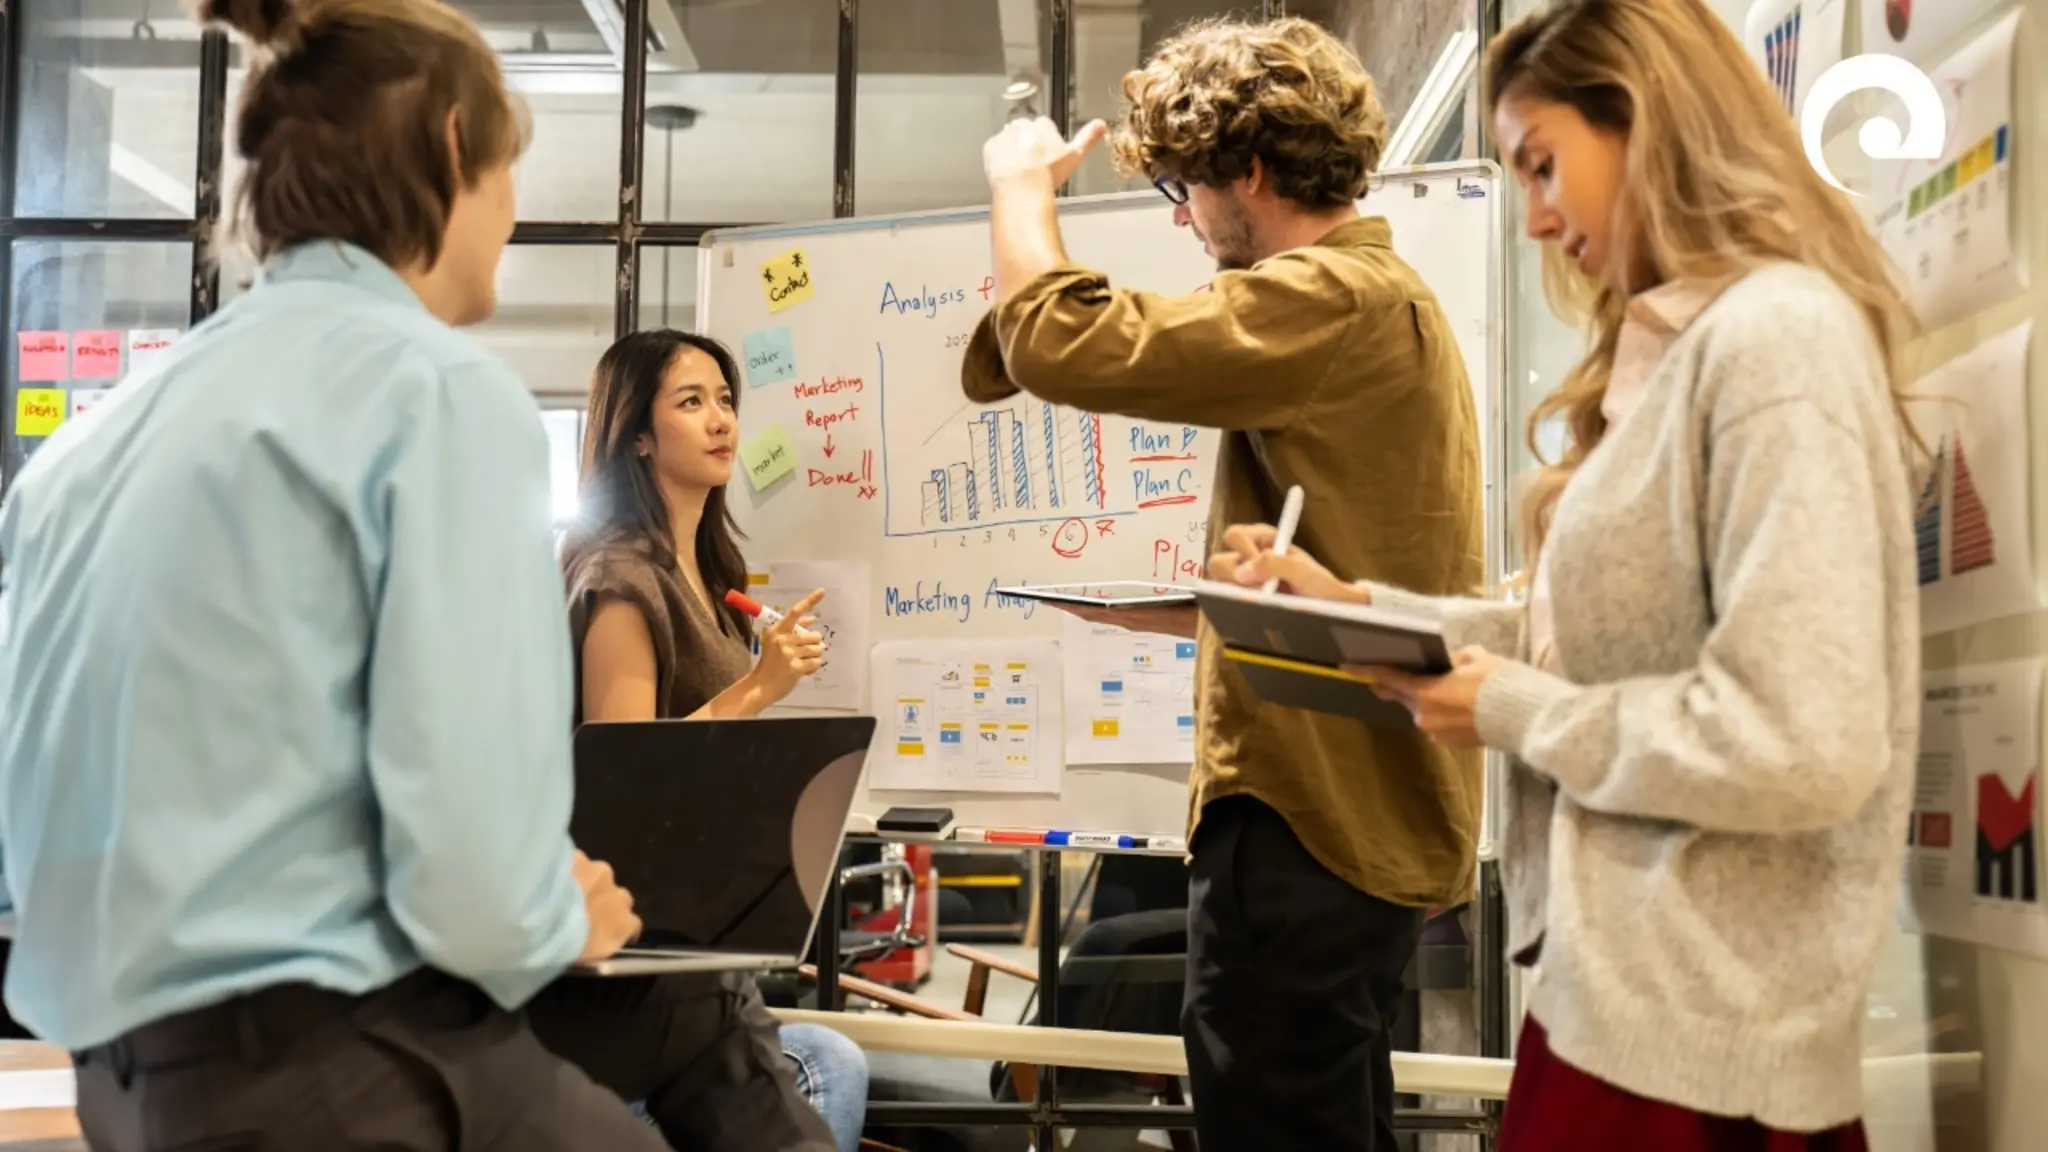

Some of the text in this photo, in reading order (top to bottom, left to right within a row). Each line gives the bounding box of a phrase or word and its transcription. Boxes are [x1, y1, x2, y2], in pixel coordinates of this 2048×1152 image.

[769, 271, 809, 302] Contact
[879, 281, 965, 320] Analysis
[794, 376, 864, 398] Marketing
[805, 402, 859, 431] Report
[1129, 425, 1170, 453] Plan
[1132, 467, 1192, 502] Plan C
[885, 580, 970, 623] Marketing
